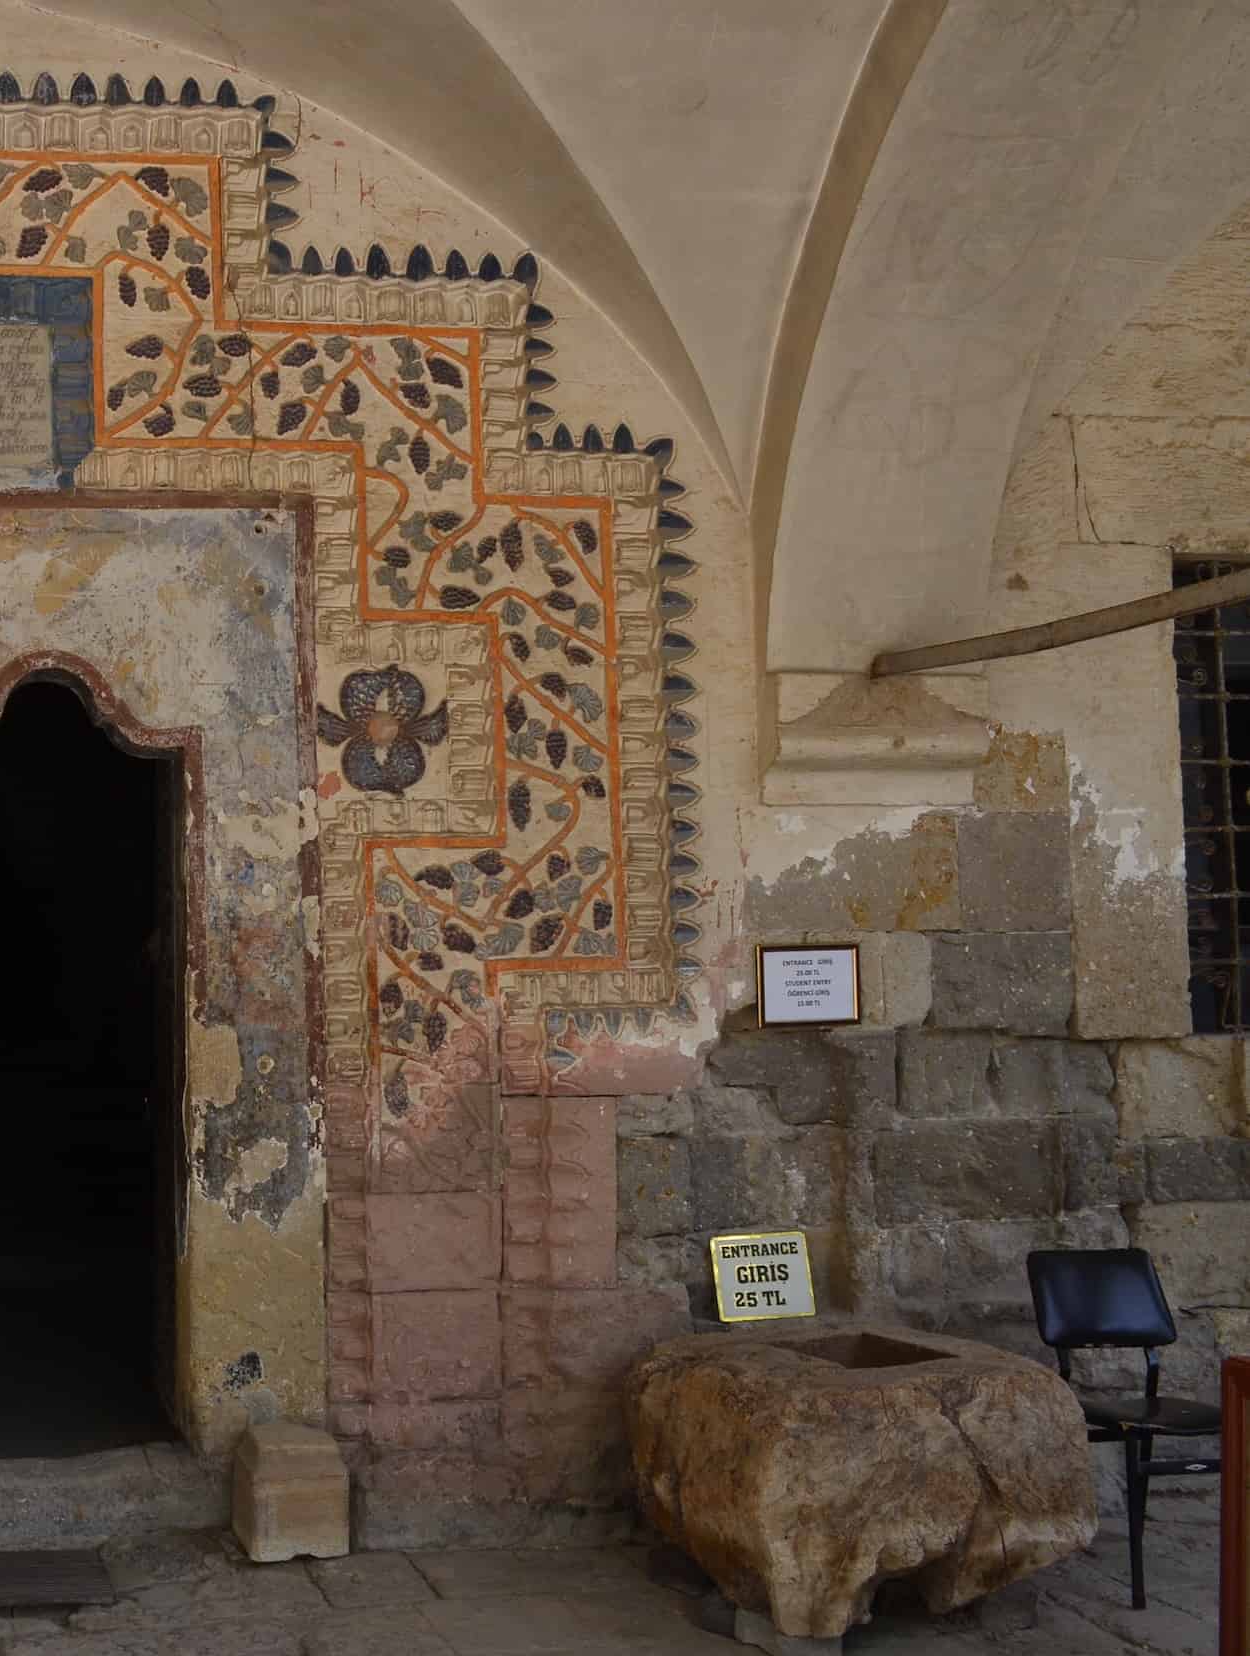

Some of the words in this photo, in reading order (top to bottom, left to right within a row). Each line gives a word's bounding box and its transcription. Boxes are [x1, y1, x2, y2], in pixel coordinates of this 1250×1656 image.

[782, 959, 813, 967] ENTRANCE
[721, 1241, 799, 1259] ENTRANCE
[736, 1261, 790, 1284] GİRİŞ
[735, 1291, 758, 1307] 25
[762, 1290, 787, 1306] TL
